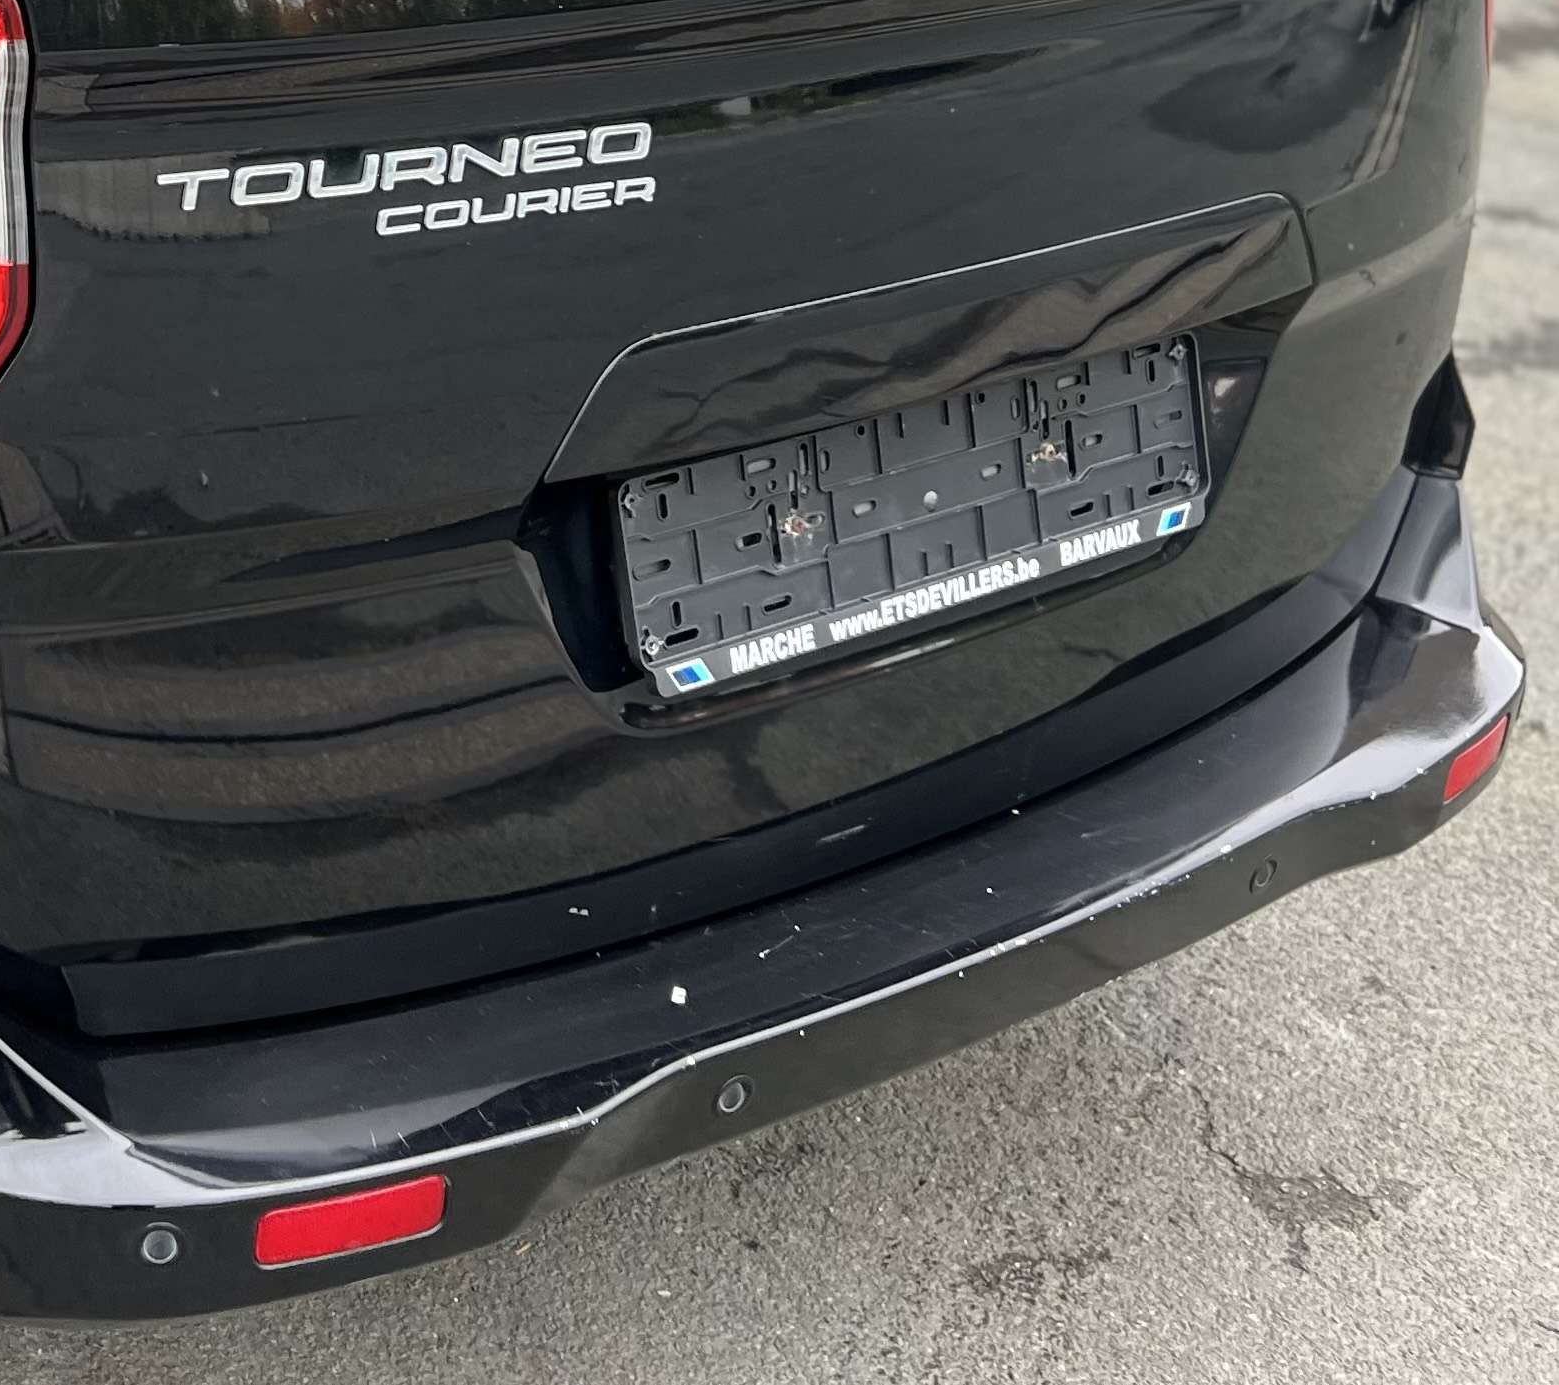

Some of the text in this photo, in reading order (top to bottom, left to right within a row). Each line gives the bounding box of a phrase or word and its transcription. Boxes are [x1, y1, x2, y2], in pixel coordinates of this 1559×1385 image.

[157, 122, 652, 211] TOURNEO
[376, 176, 656, 236] COURIER
[729, 519, 1142, 674] MARCHE www.ETSDEVILLERS.be BARVAUX
